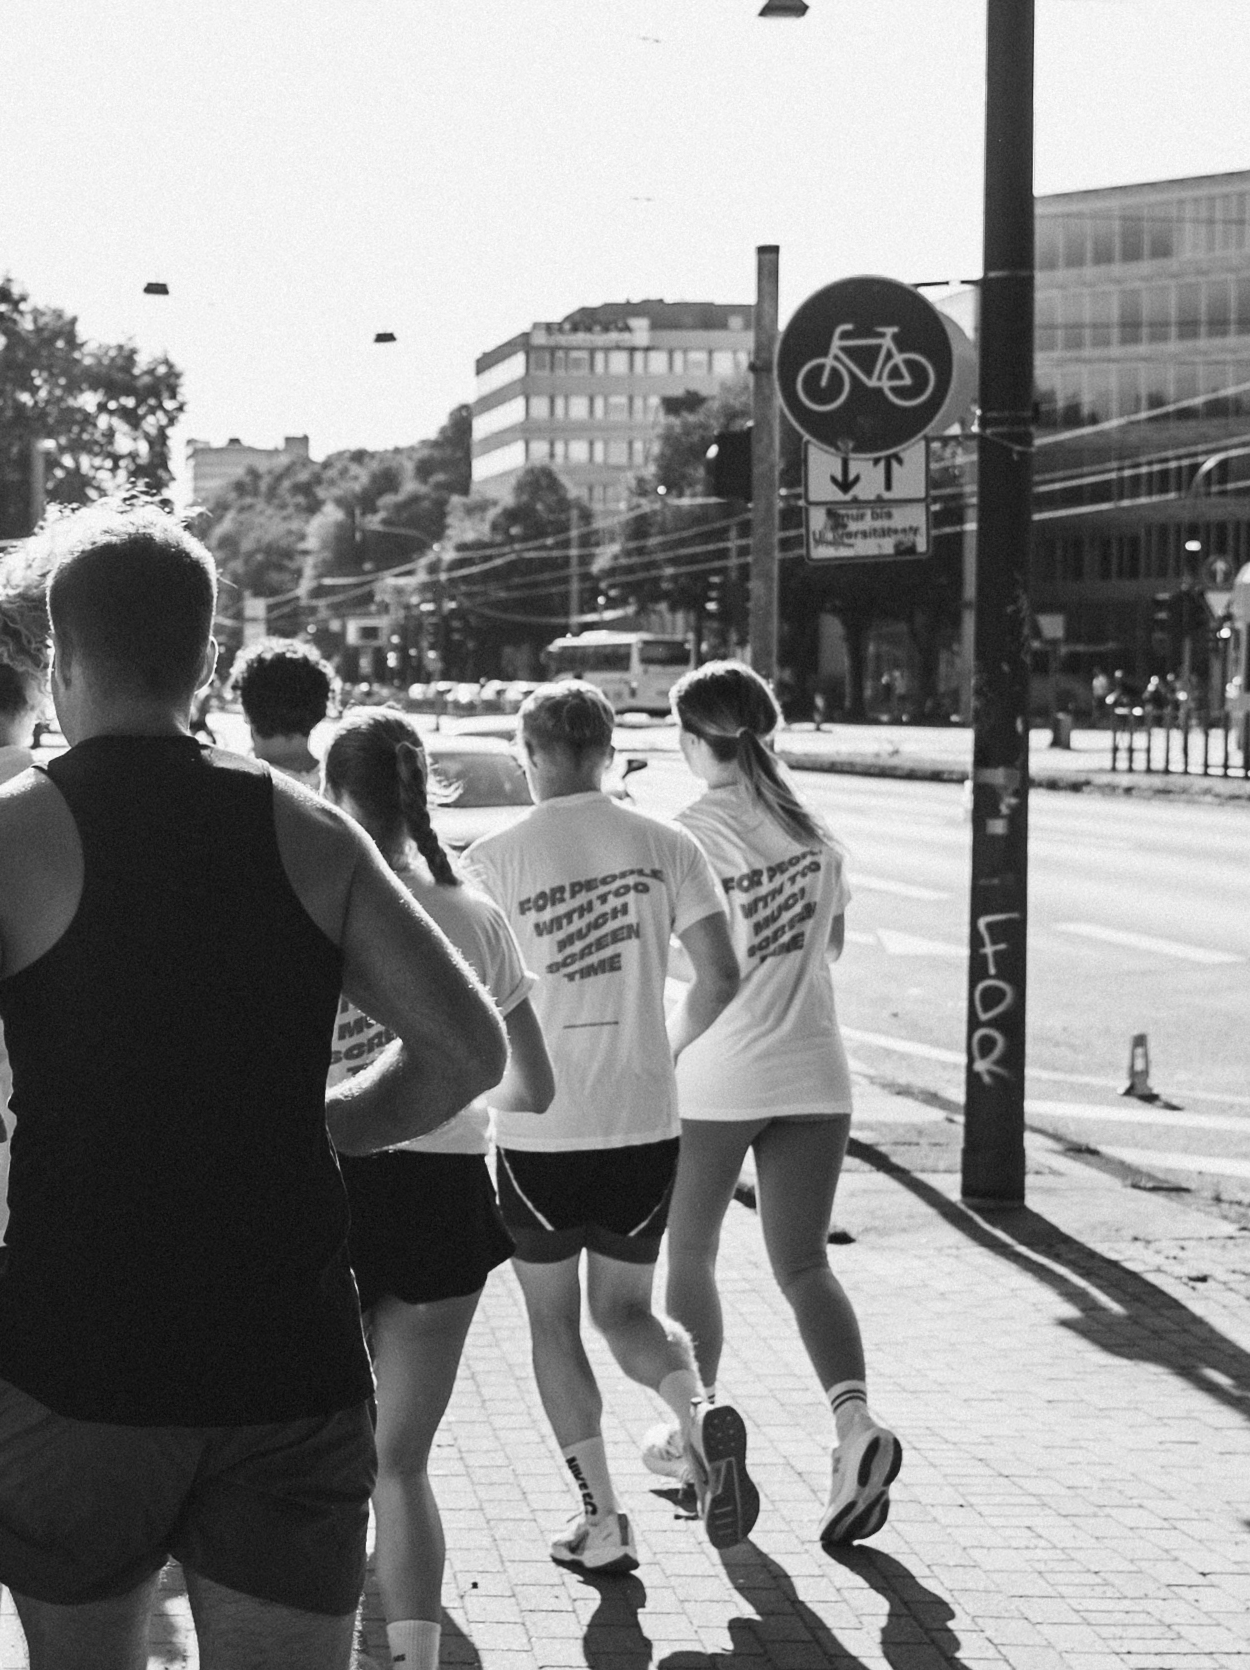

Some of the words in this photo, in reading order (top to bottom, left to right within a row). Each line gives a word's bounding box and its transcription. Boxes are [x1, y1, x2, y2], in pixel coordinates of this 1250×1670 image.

[518, 885, 566, 915] FOR
[569, 868, 665, 899] PEOPLE
[721, 868, 763, 895] FOR
[534, 899, 593, 937] WITH
[596, 882, 650, 905] TOO
[556, 902, 628, 953] MUCH
[546, 922, 640, 974] SCREEN
[563, 952, 622, 982] TIME
[972, 912, 1021, 1086] FOR
